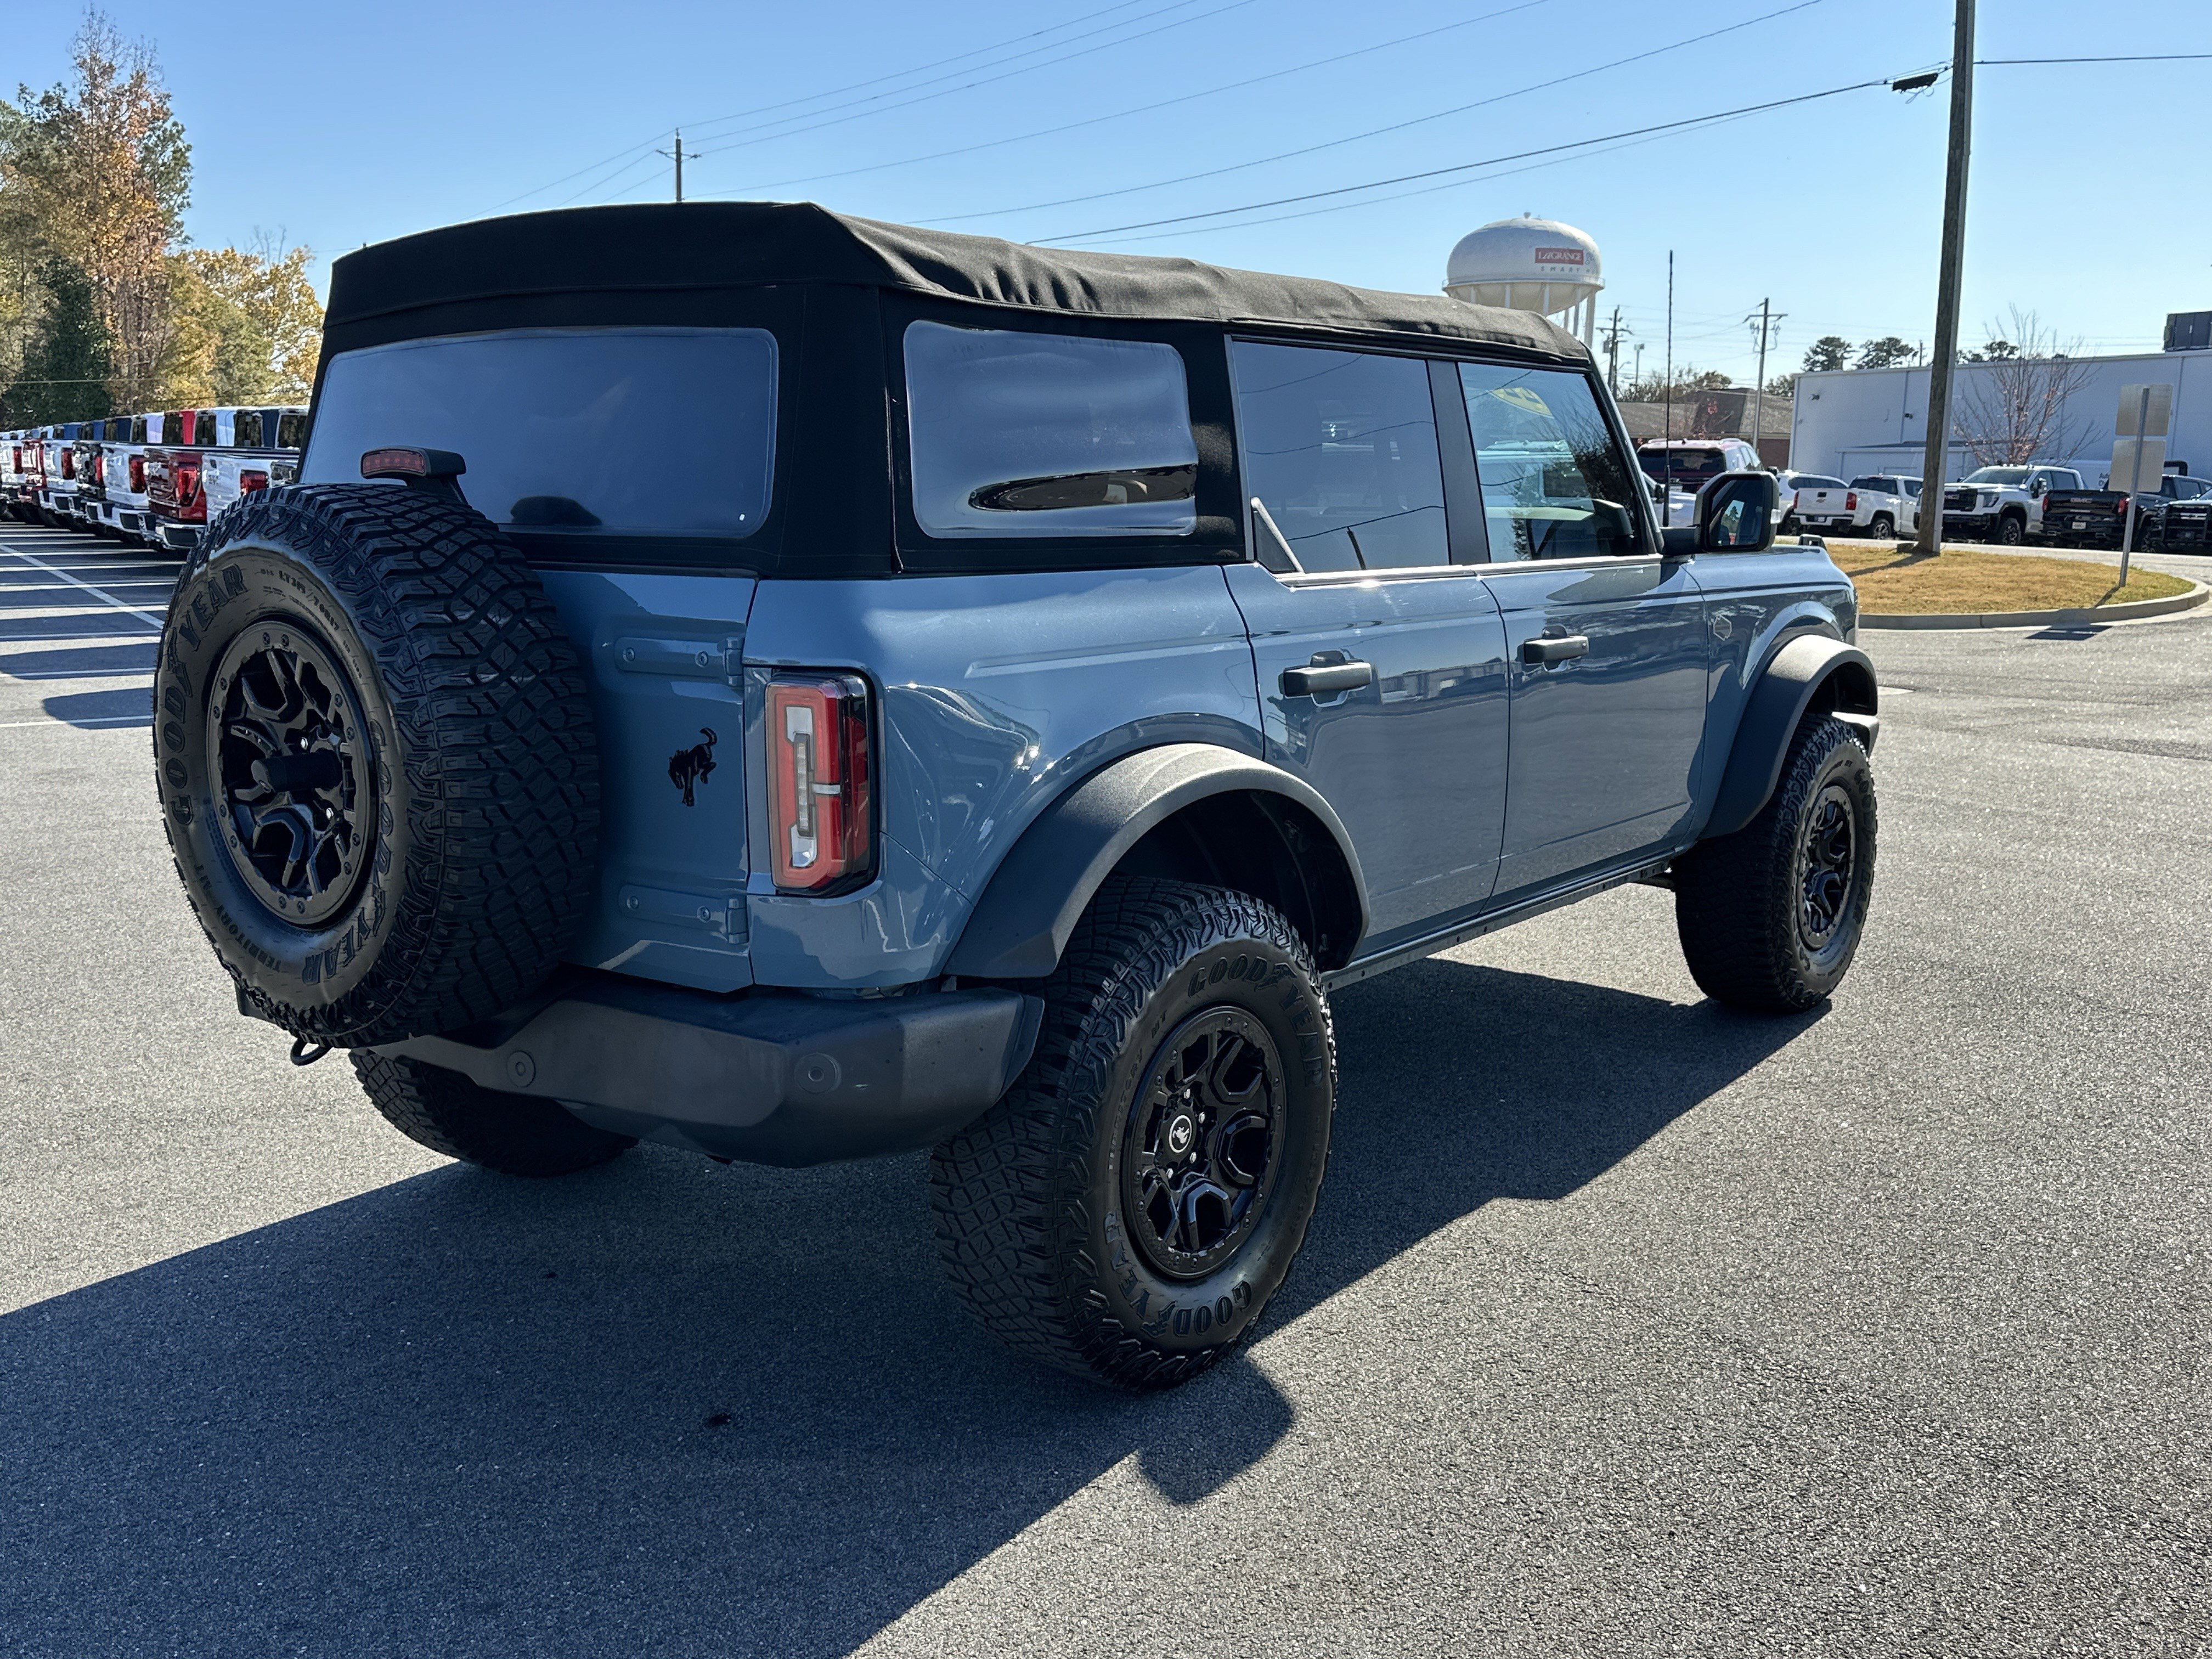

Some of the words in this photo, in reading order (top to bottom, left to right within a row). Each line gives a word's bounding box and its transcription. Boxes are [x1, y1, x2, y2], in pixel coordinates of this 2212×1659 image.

[164, 563, 247, 825] GOODYEAR
[215, 905, 281, 973] TERRITORY
[1188, 953, 1323, 1087] GOODYEAR
[1103, 1209, 1252, 1339] GOODYEAR
